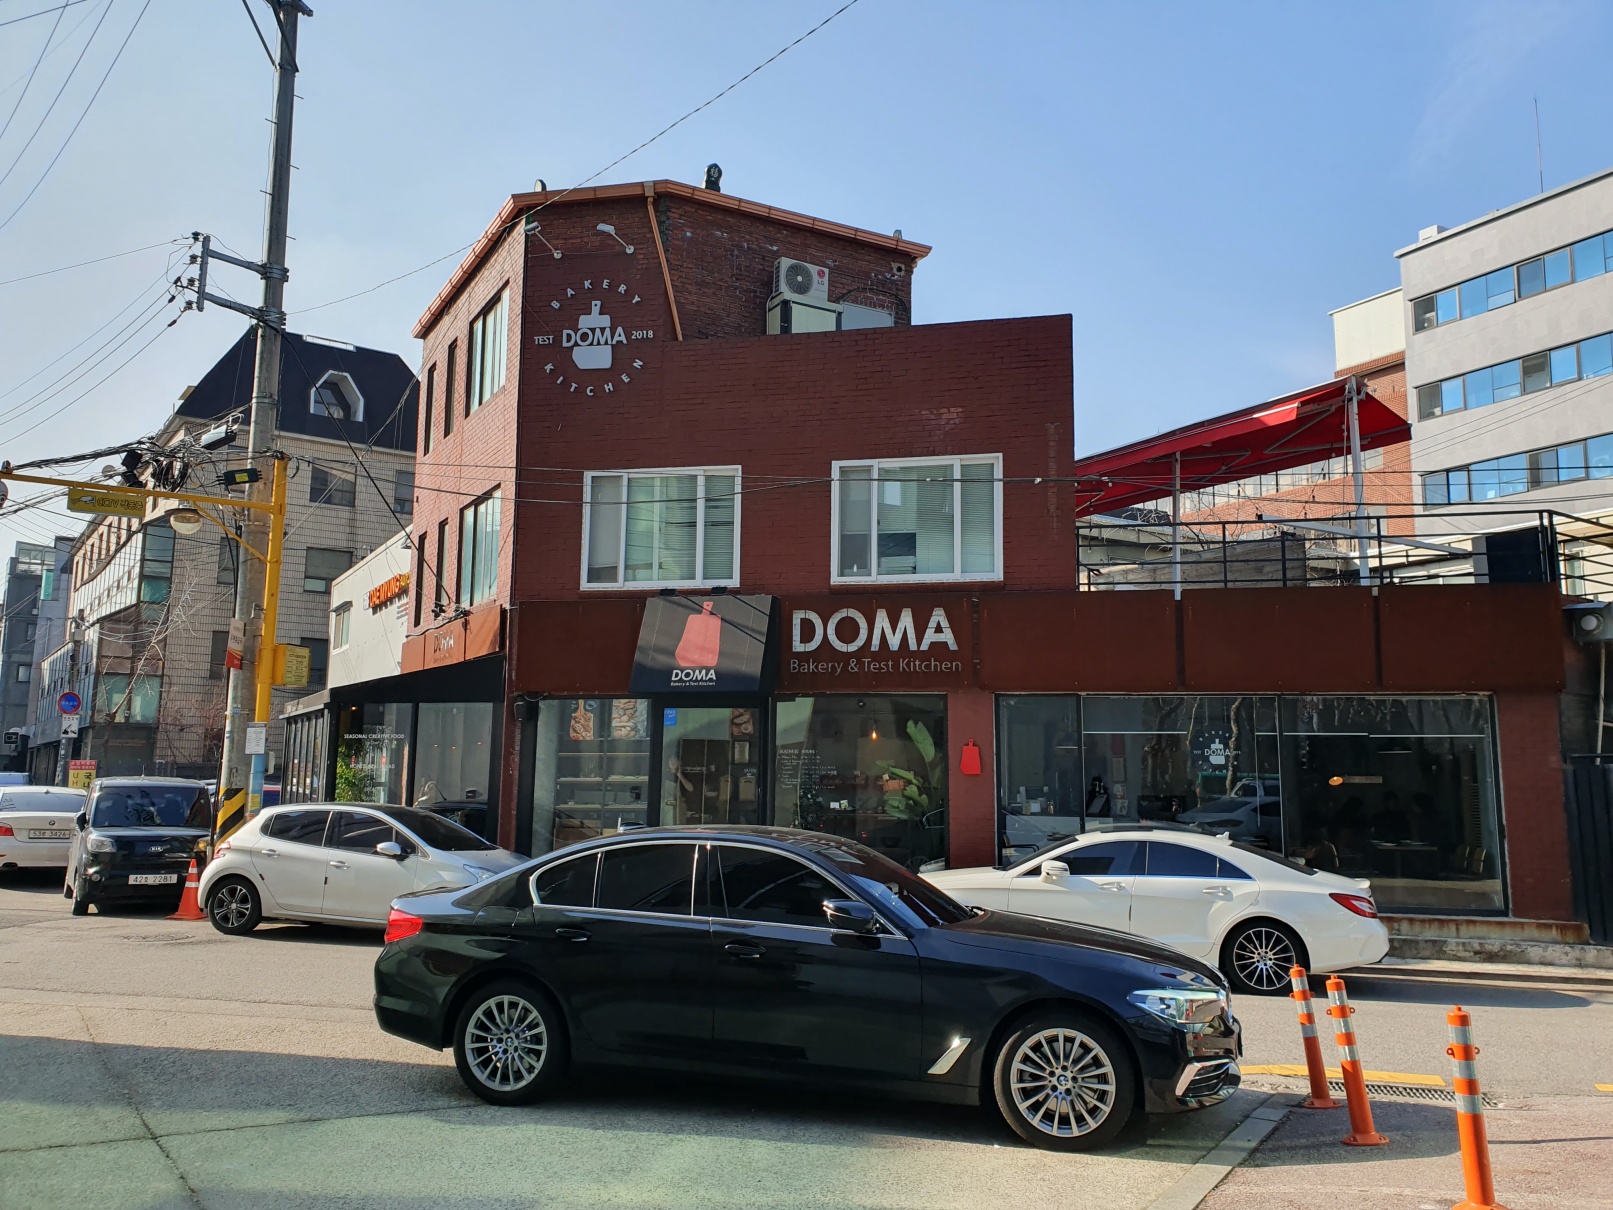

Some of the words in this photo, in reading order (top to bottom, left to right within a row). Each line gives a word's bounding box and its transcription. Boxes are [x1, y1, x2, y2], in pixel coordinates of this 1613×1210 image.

[551, 279, 641, 310] BAKERY
[534, 335, 554, 345] TEST
[562, 327, 627, 347] DOMA
[631, 330, 653, 339] 2018
[544, 359, 643, 395] KITCHEN
[792, 607, 959, 653] DOMA
[671, 669, 716, 681] DOMA
[790, 658, 843, 676] Bakery
[848, 658, 859, 673] &
[862, 658, 894, 673] Test
[900, 657, 962, 673] Kitchen
[1204, 748, 1231, 756] DOMA
[152, 875, 173, 883] 2281
